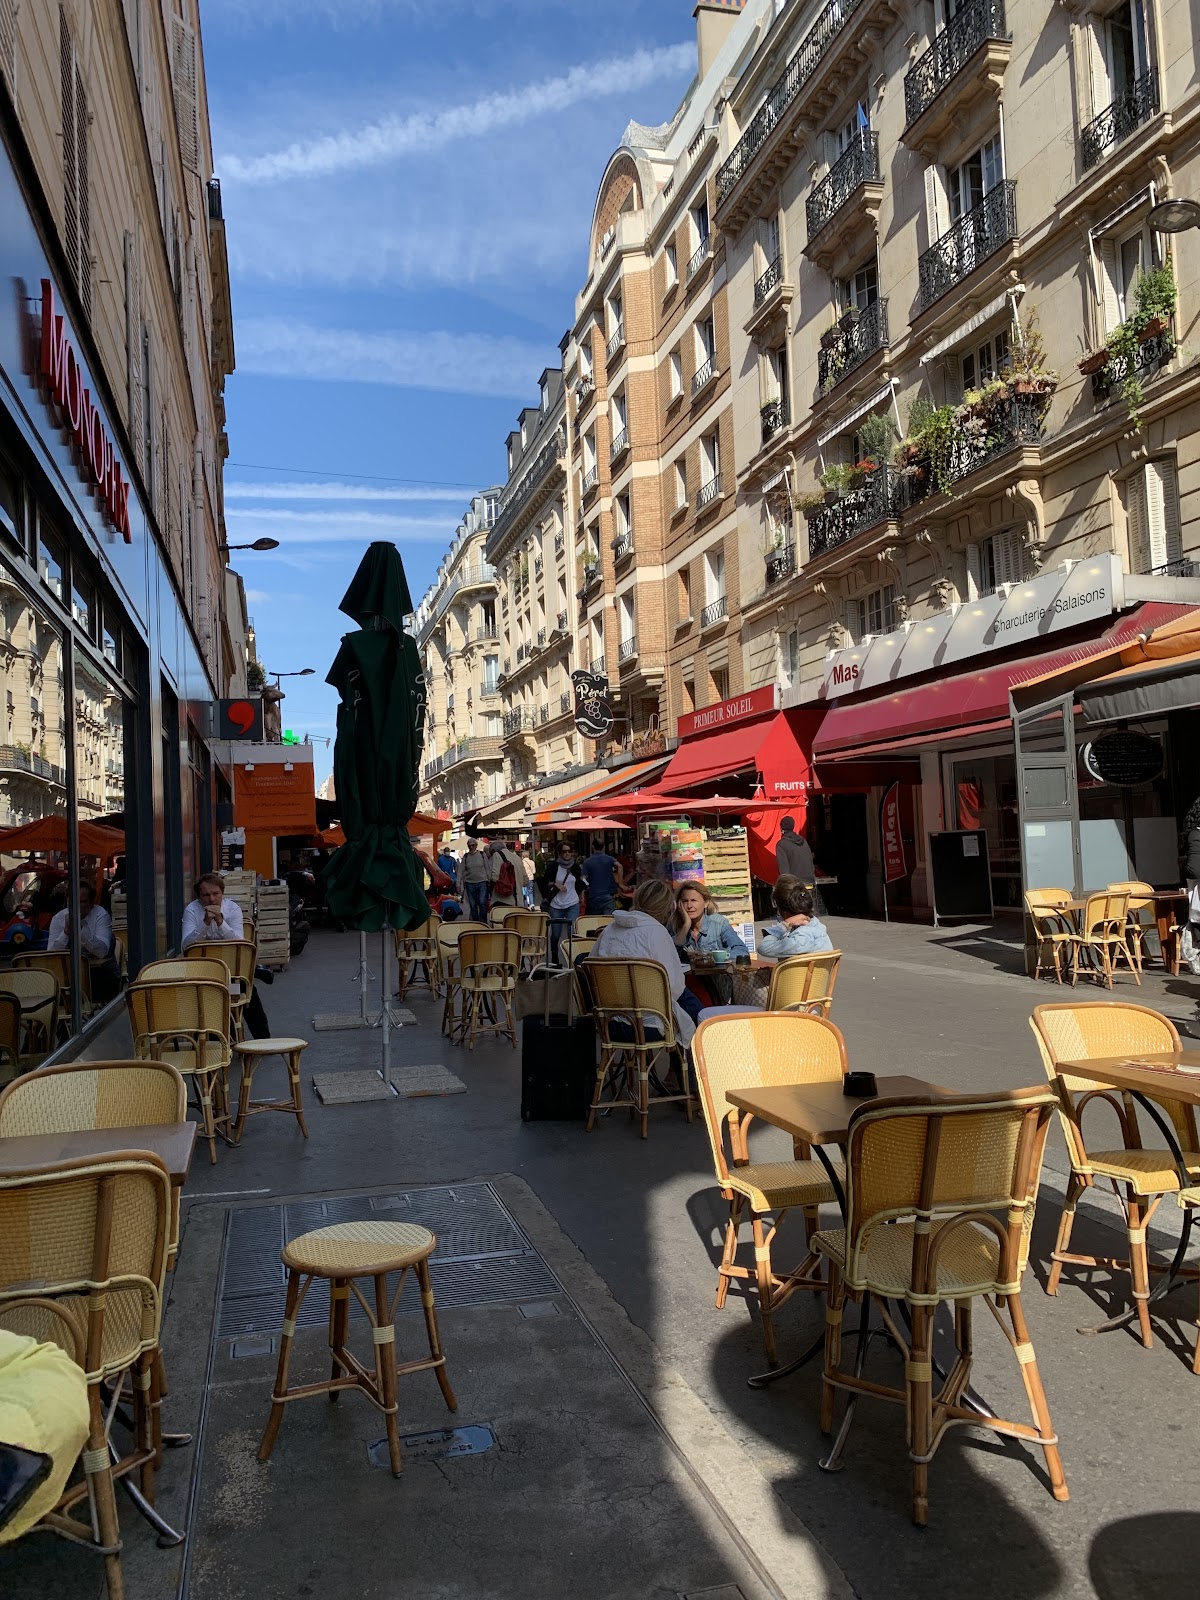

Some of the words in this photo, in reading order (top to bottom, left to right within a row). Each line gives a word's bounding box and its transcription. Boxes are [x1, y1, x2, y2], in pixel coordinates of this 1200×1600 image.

[993, 607, 1046, 634] Charcuterie
[1055, 587, 1105, 614] Salaisons
[833, 663, 859, 686] Mas
[575, 683, 608, 701] Péret
[693, 708, 724, 729] PRIMEUR
[726, 697, 754, 719] SOLEIL
[774, 781, 805, 791] FRUITS
[885, 802, 898, 853] Mas
